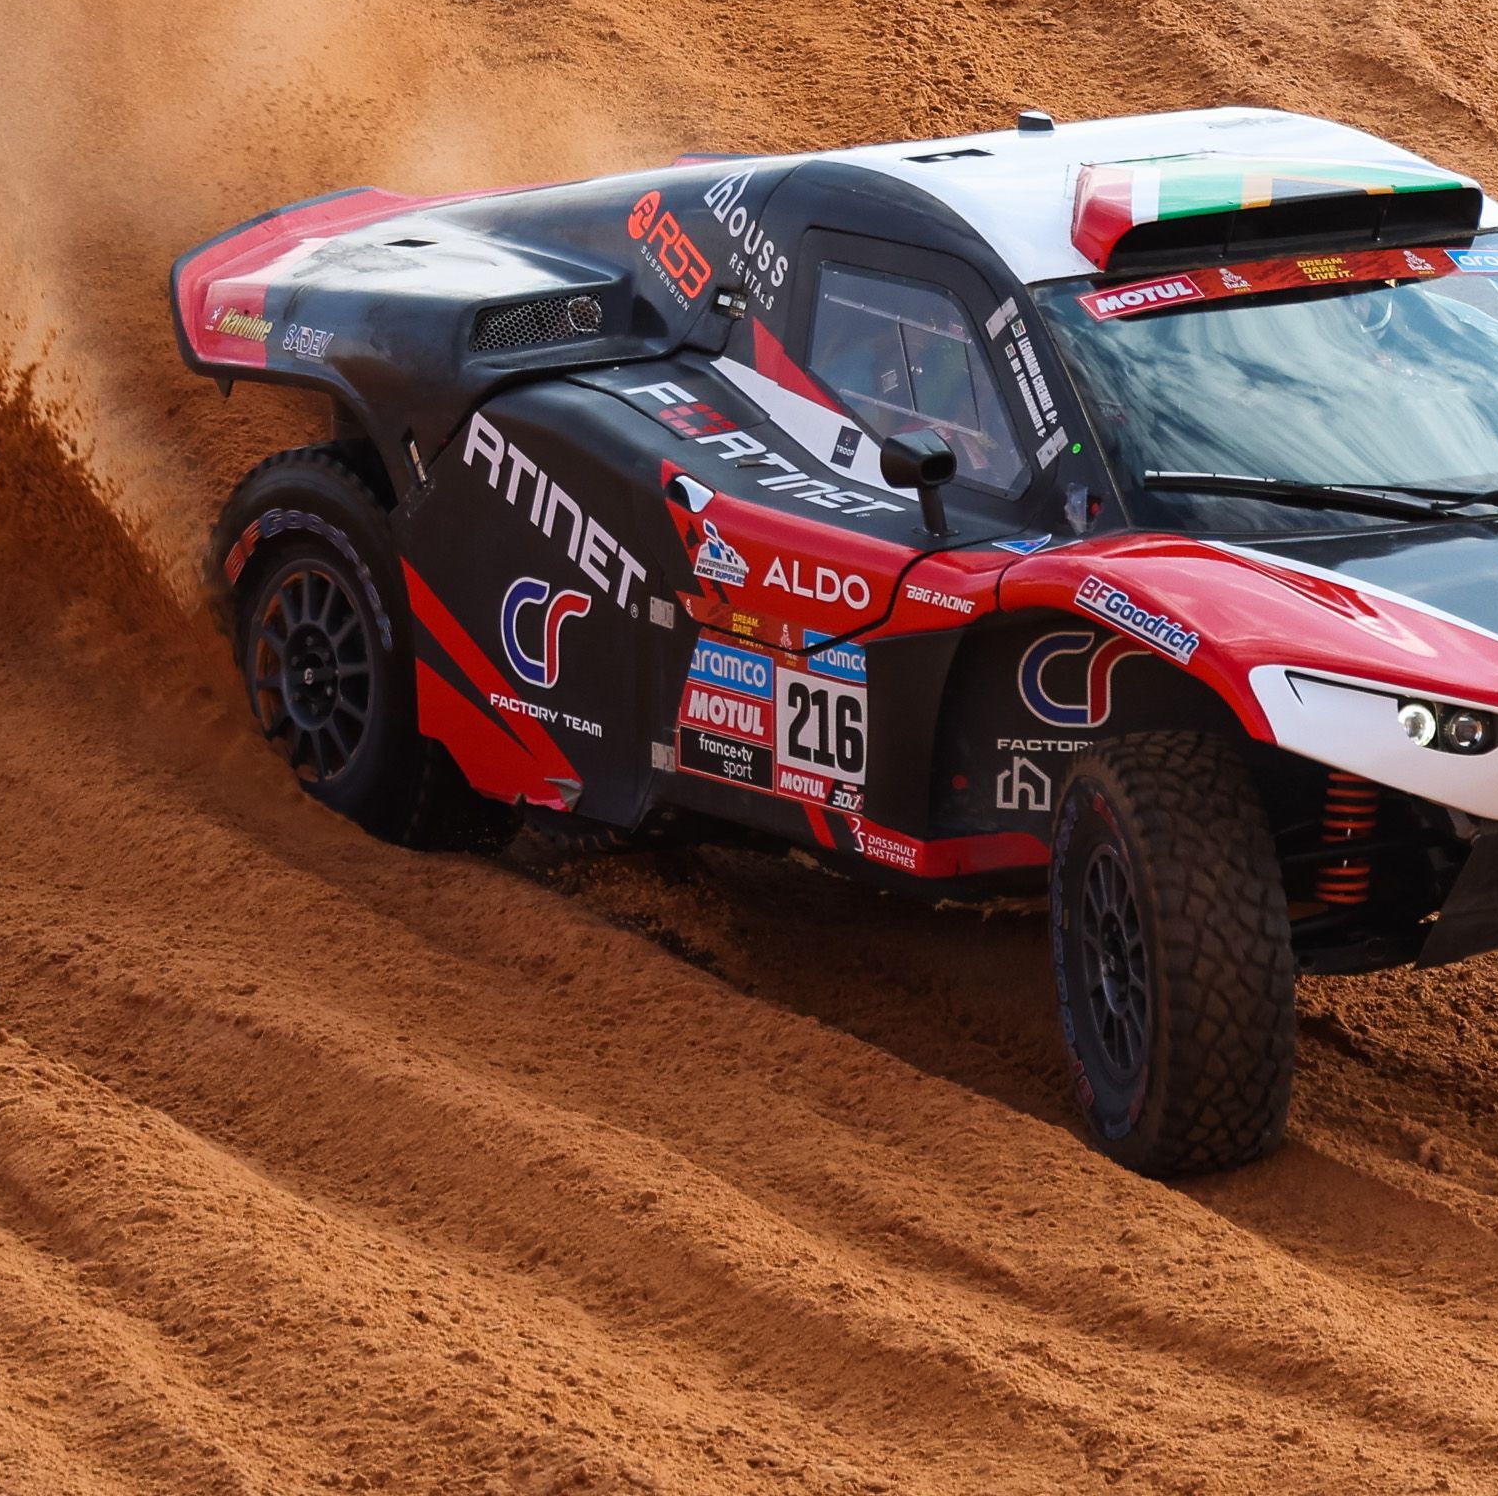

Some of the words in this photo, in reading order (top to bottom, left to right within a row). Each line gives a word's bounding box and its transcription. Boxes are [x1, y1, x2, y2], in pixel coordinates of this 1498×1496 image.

[641, 245, 690, 311] SUSPENSION
[1296, 257, 1347, 268] DREAM.
[1302, 265, 1341, 275] DARE.
[1309, 272, 1338, 281] LIVE
[1339, 270, 1354, 278] IT.
[1095, 281, 1194, 313] MOTUL
[217, 307, 274, 343] Havoline
[283, 324, 334, 357] SADEV
[1017, 336, 1042, 378] LEONARD
[1032, 374, 1054, 413] CREMER
[623, 381, 906, 514] FORTINET
[463, 411, 647, 609] RTINET
[696, 565, 713, 577] RACE
[762, 555, 871, 610] ALDO
[906, 584, 932, 603] BBG
[931, 592, 976, 615] RACING
[732, 612, 760, 628] DREAM.
[1078, 577, 1198, 655] BFGoodrich
[690, 647, 767, 688] aramco
[490, 693, 559, 724] FACTORY
[563, 713, 603, 738] TEAM
[688, 690, 764, 736] MOTUL
[788, 682, 865, 774] 216
[997, 739, 1093, 752] FACTOR
[723, 759, 753, 780] sport
[780, 771, 826, 799] MOTUL
[866, 845, 916, 869] SYSTEMES
[868, 835, 918, 857] DASSAULT
